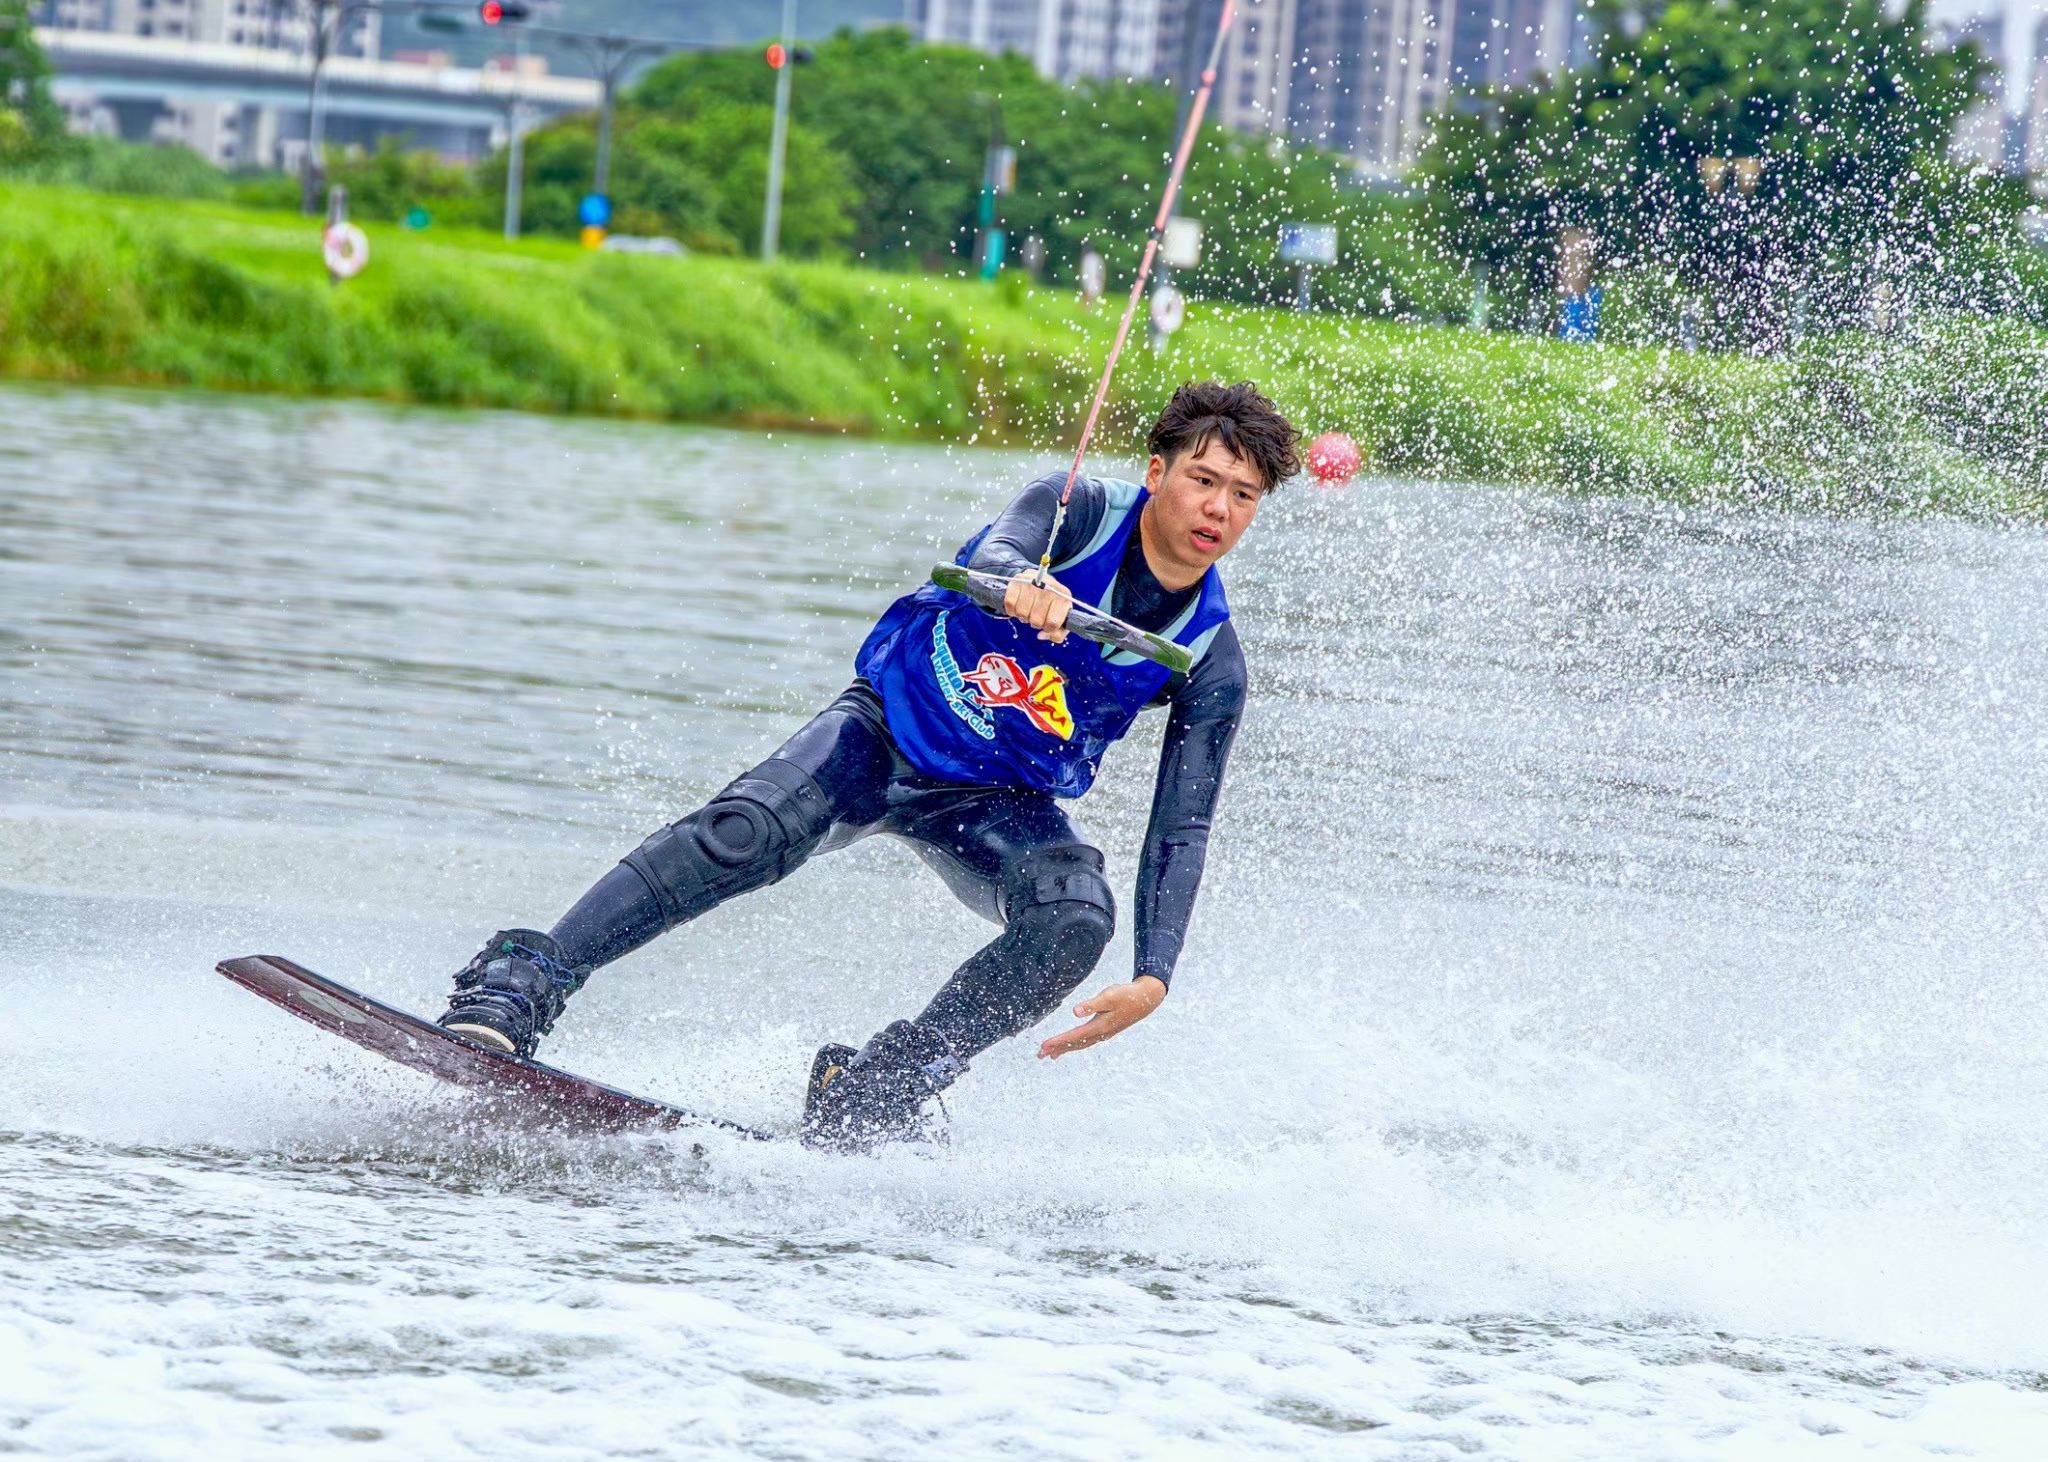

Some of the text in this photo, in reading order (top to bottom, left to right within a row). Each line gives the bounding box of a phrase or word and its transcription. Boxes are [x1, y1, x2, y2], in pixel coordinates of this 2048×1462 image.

[934, 660, 995, 739] Water Ski Club
